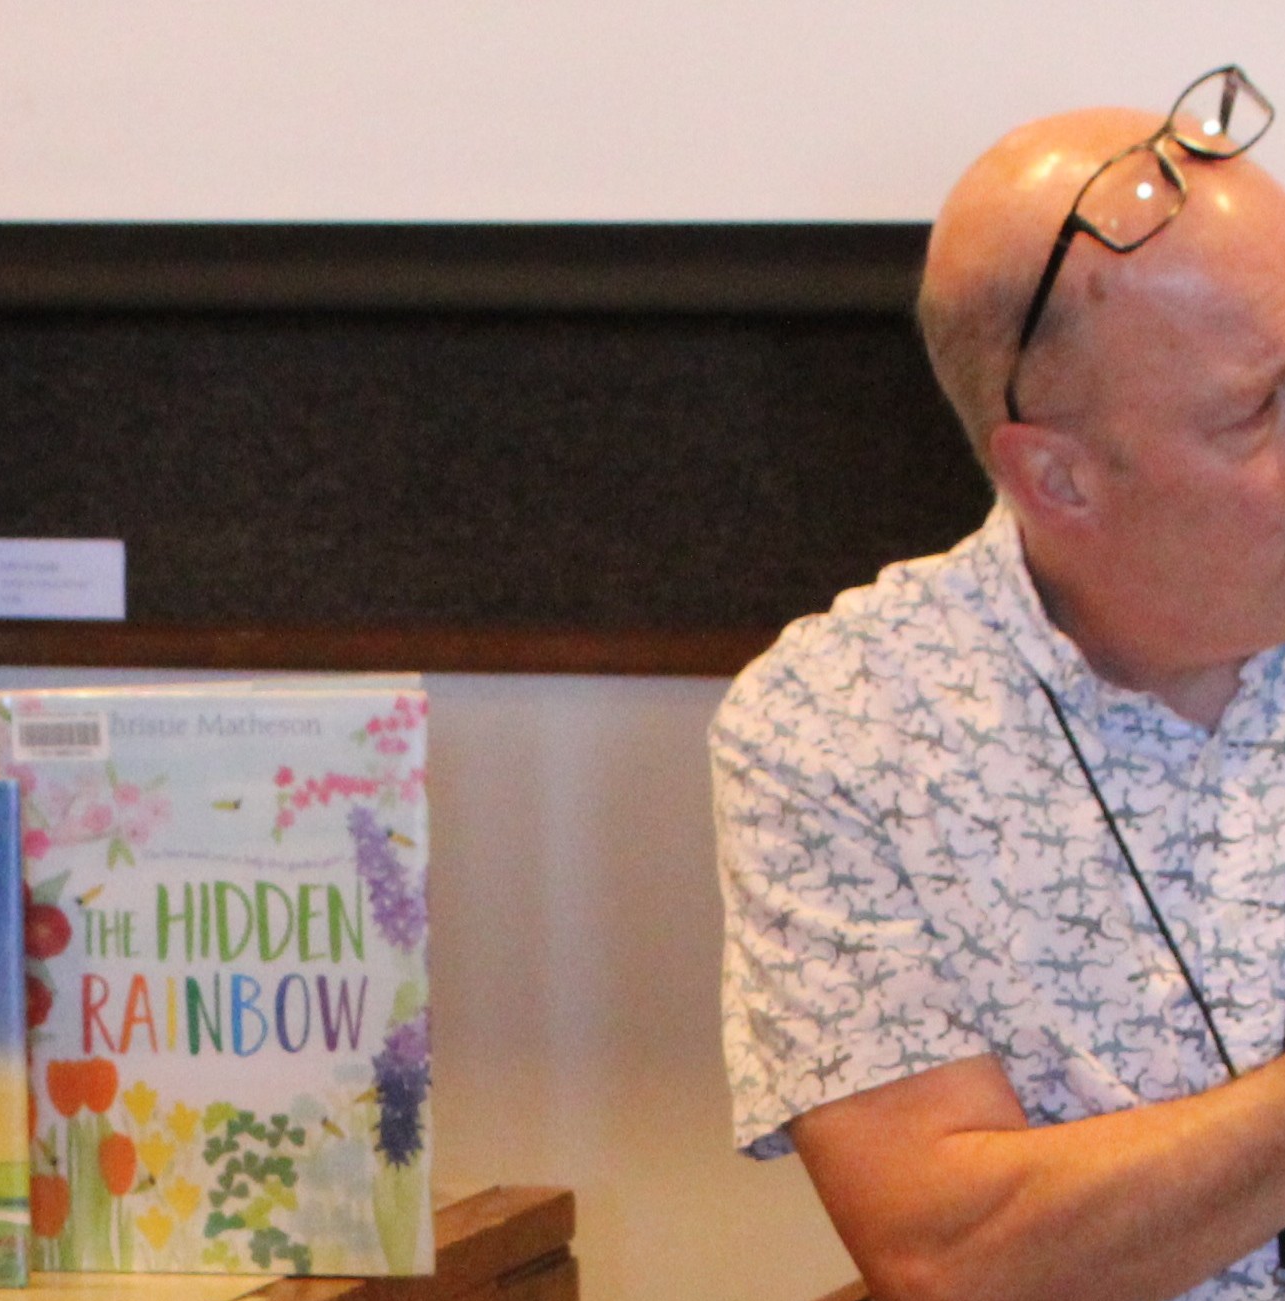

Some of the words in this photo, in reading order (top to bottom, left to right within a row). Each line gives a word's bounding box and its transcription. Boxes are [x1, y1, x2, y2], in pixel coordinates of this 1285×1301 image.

[108, 711, 188, 737] hristie
[197, 713, 322, 738] Matheson
[83, 909, 141, 960] THE
[156, 881, 366, 963] HIDDEN
[82, 973, 368, 1057] RAINBOW
